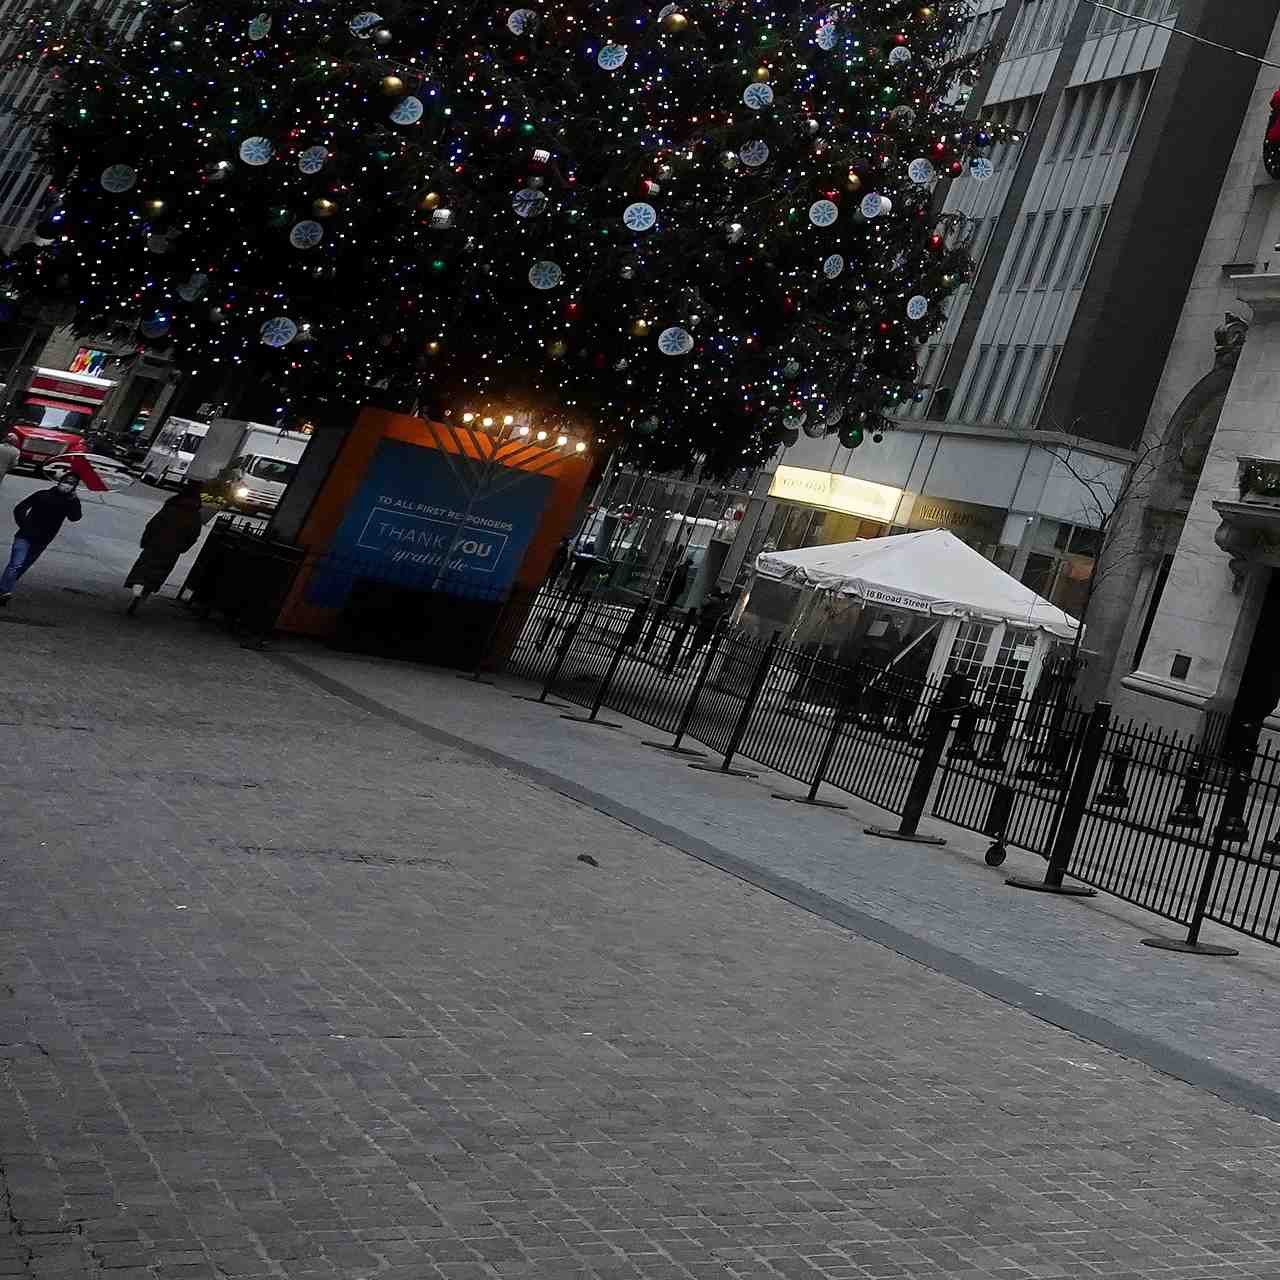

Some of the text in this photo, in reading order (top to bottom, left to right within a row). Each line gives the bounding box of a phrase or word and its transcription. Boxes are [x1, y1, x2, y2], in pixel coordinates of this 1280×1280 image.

[377, 495, 513, 531] TO ALL FIRST REPONDERS
[378, 522, 493, 558] THANK YOU
[876, 590, 902, 604] Broad
[903, 597, 929, 609] Street
